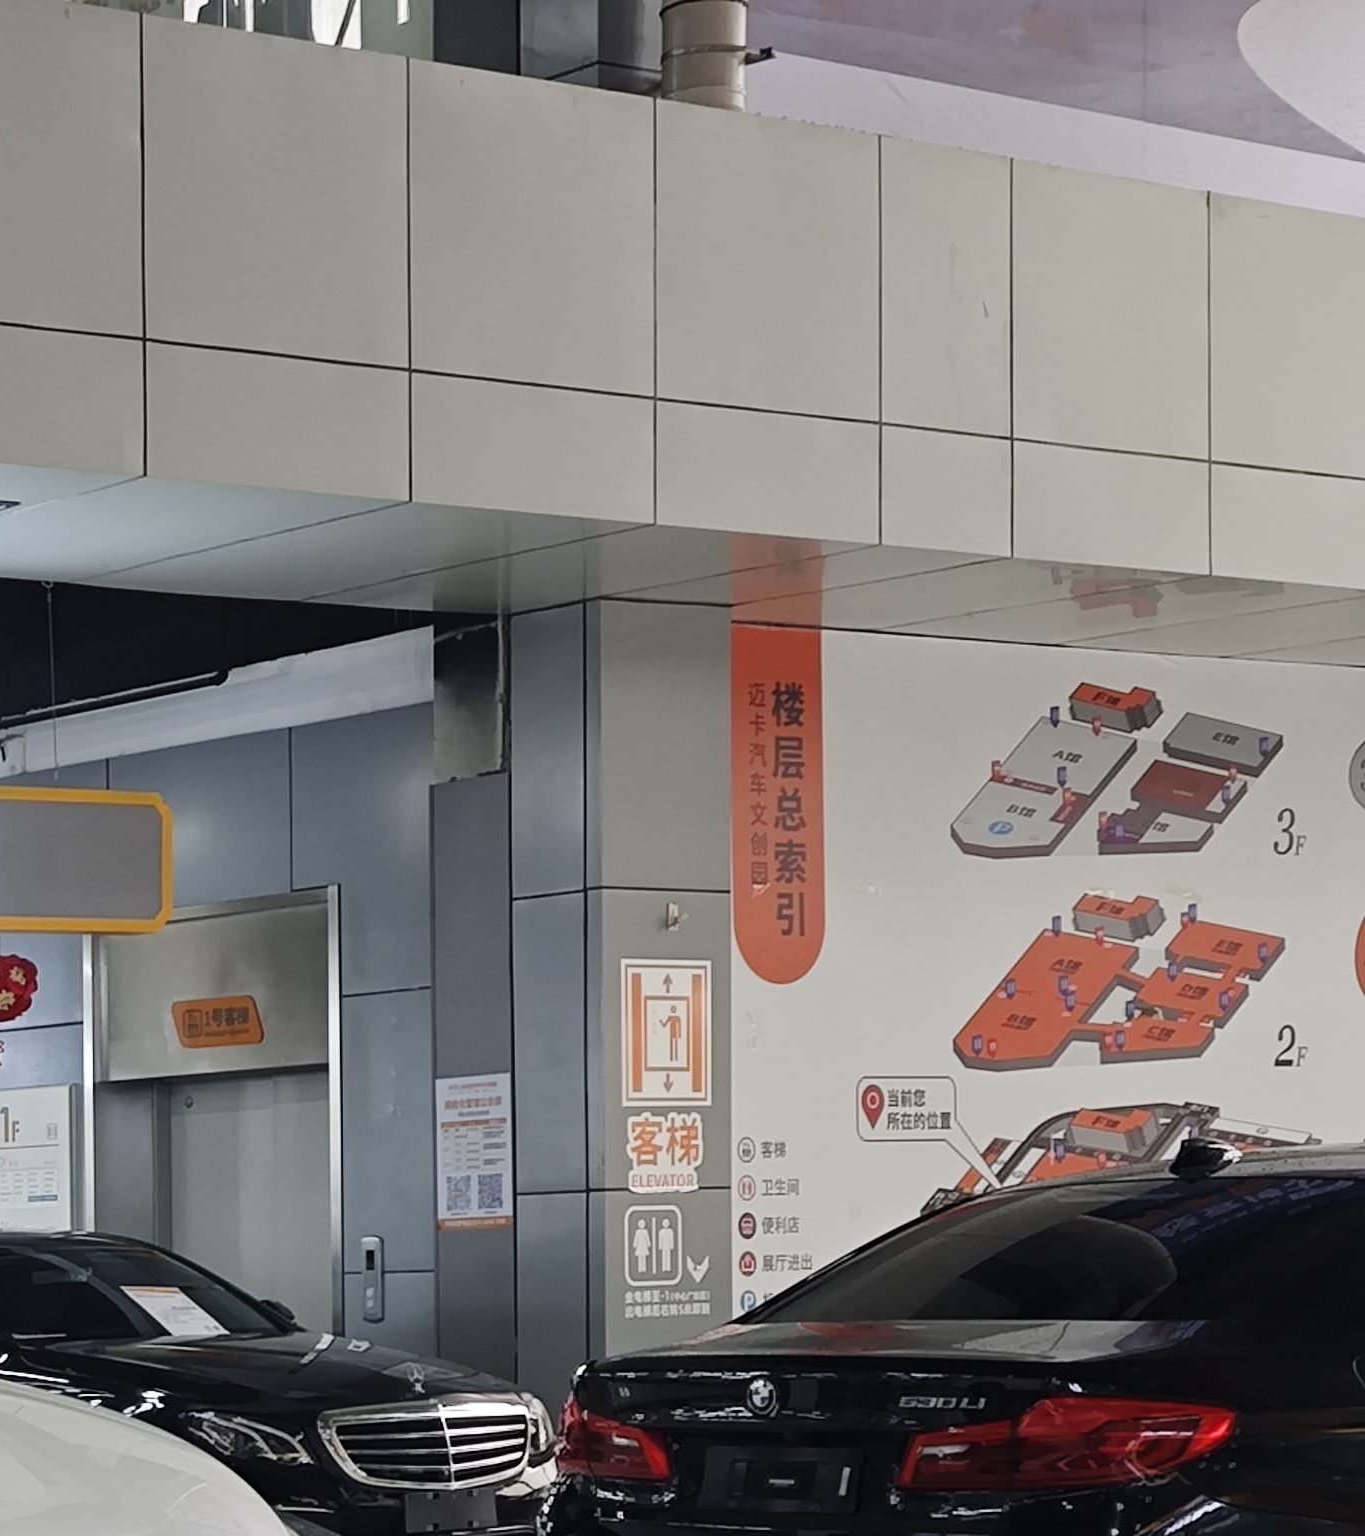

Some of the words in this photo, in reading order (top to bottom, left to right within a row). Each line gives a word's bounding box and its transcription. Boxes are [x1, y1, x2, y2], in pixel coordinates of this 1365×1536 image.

[747, 682, 768, 886] 迈卡汽车文创园
[771, 681, 807, 937] 楼层总索引
[1273, 808, 1307, 856] 3F
[1273, 1025, 1309, 1068] 2F
[887, 1089, 925, 1107] 当前您
[0, 1106, 20, 1143] 1F
[887, 1112, 952, 1131] 所在的位置
[631, 1117, 700, 1166] 客梯
[760, 1140, 787, 1159] 客梯
[631, 1173, 695, 1188] ELEVATOR
[761, 1178, 800, 1197] 卫生间
[761, 1216, 800, 1235] 便利店
[761, 1254, 813, 1272] 展厅进出
